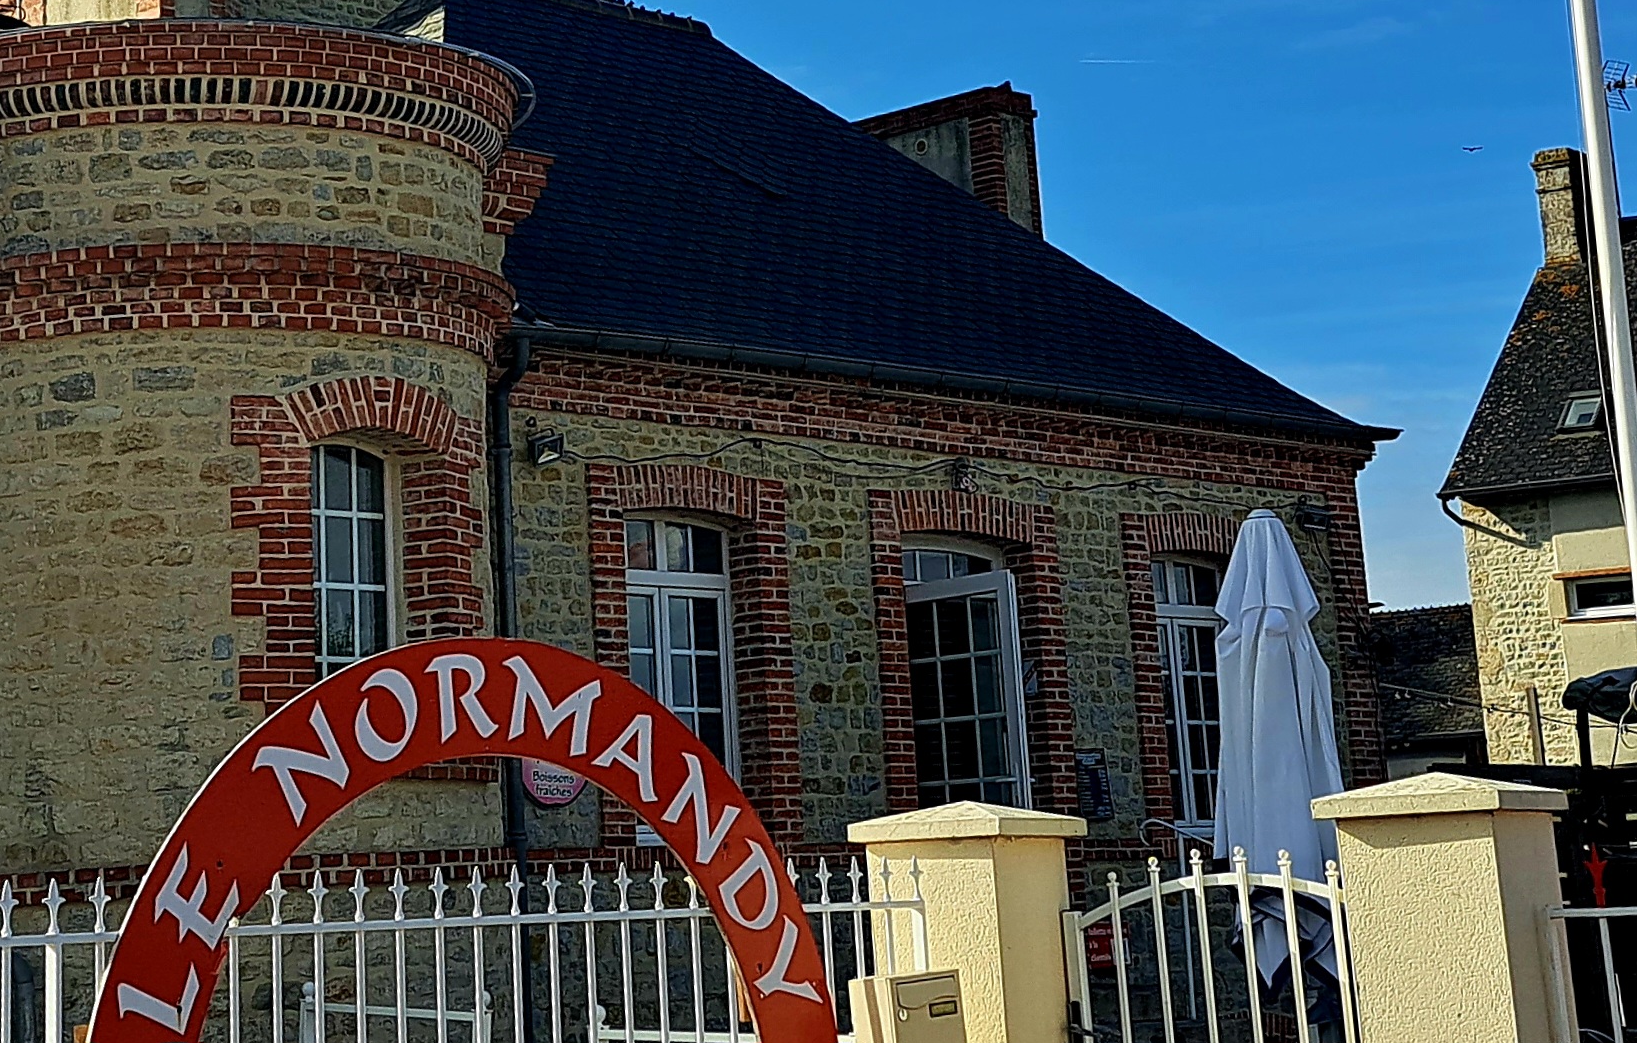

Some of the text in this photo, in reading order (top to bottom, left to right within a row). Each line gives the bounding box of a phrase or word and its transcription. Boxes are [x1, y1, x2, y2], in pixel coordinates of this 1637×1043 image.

[117, 654, 823, 1035] LE NORMANDY
[532, 770, 575, 784] Boissons
